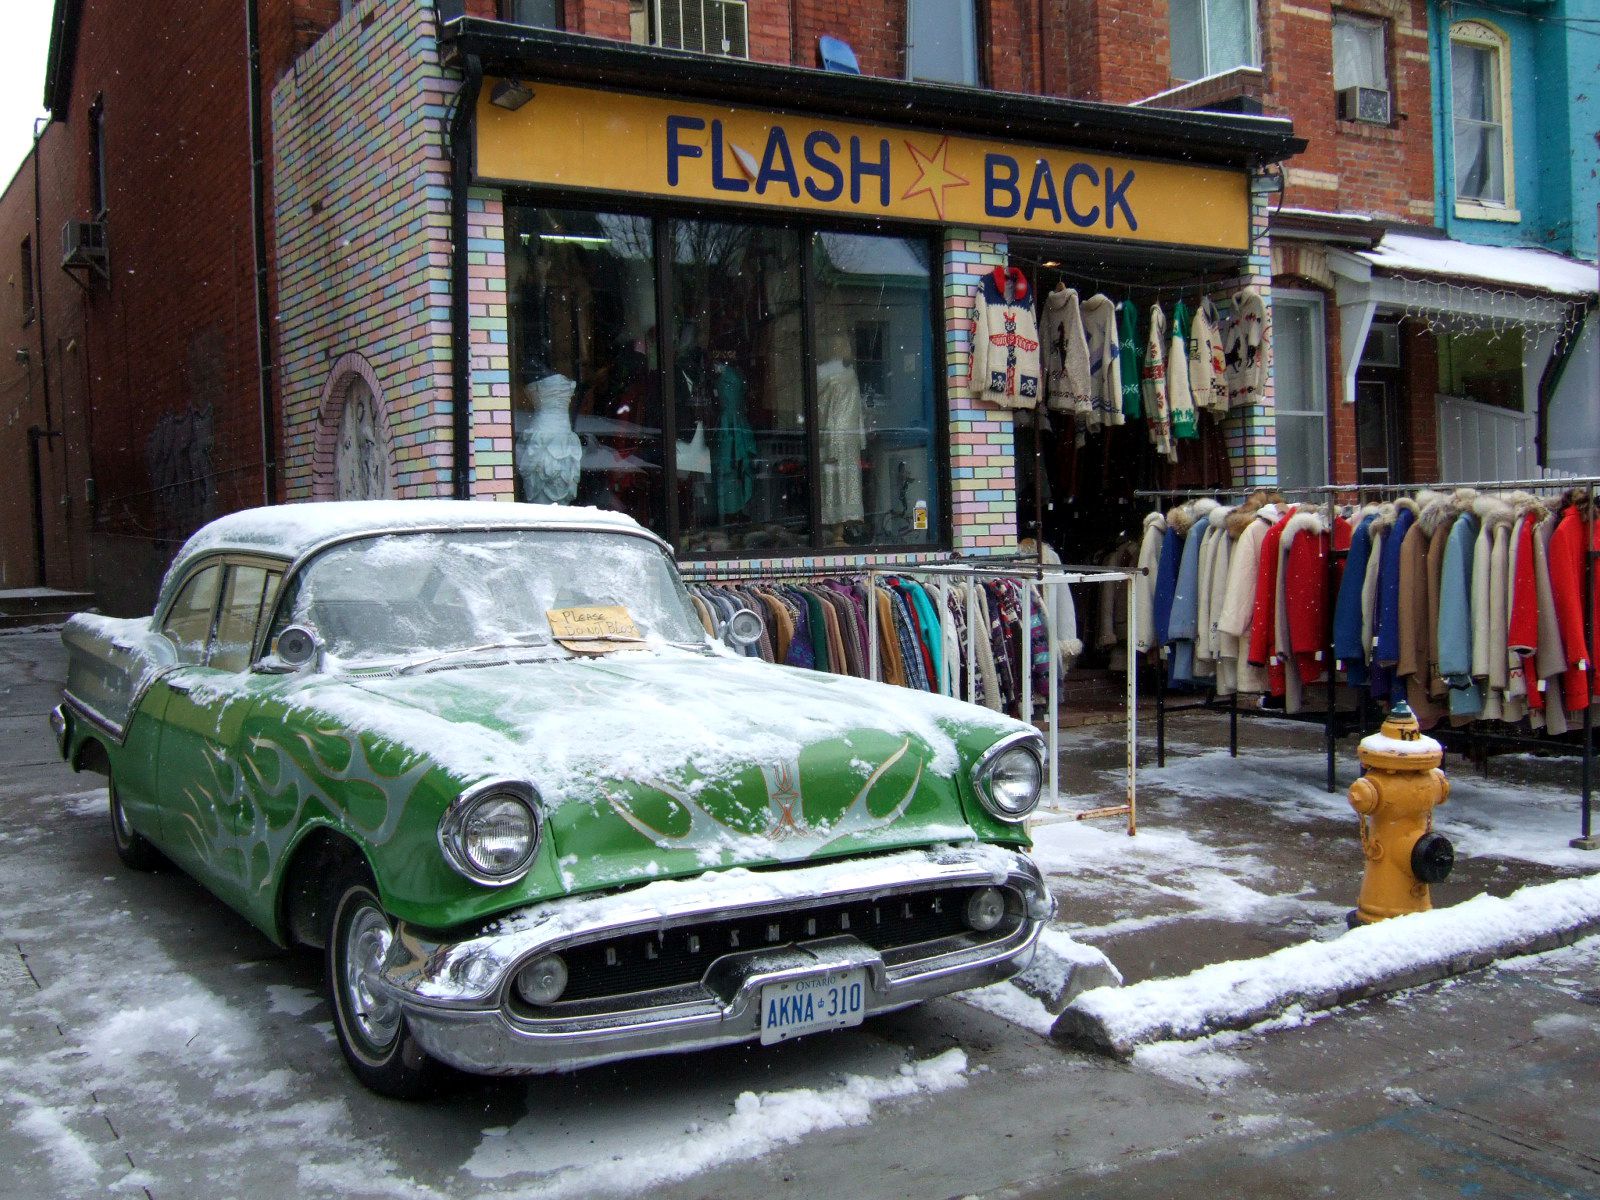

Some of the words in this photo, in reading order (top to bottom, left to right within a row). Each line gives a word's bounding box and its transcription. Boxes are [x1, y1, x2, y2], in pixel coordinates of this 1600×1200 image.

[666, 114, 890, 207] FLASH
[984, 152, 1138, 231] BACK
[767, 992, 814, 1029] AKNA
[827, 982, 861, 1017] 310
[796, 976, 837, 992] ONTARIO
